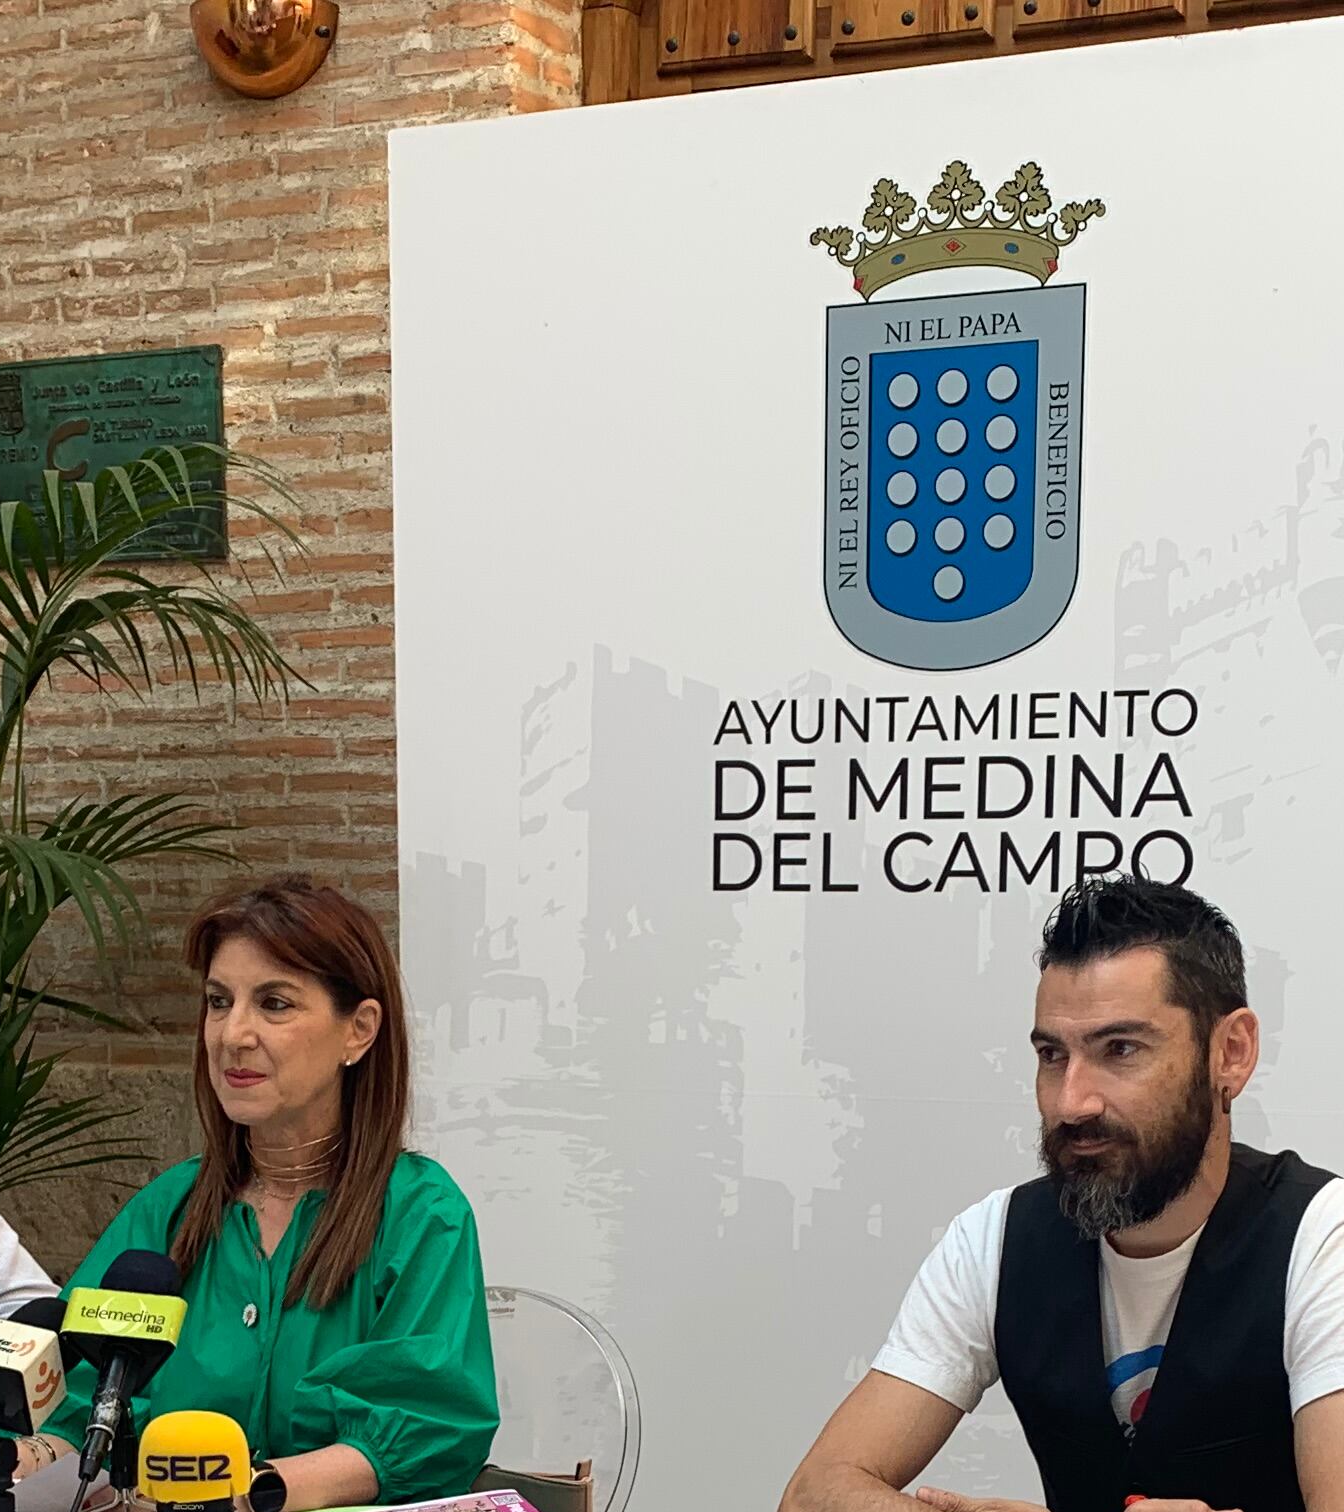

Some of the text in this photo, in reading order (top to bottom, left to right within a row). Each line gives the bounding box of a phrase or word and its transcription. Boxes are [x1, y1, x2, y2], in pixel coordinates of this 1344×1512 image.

[884, 312, 1022, 345] NI EL PAPA
[839, 356, 861, 590] NI EL REY OFICIO
[1045, 381, 1070, 540] BENEFICIO
[713, 688, 1198, 745] AYUNTAMIENTO
[713, 752, 1192, 821] DE MEDINA
[711, 829, 1194, 893] DEL CAMPO
[81, 1305, 165, 1325] telemedina
[146, 1324, 163, 1333] HD
[146, 1455, 232, 1481] SER
